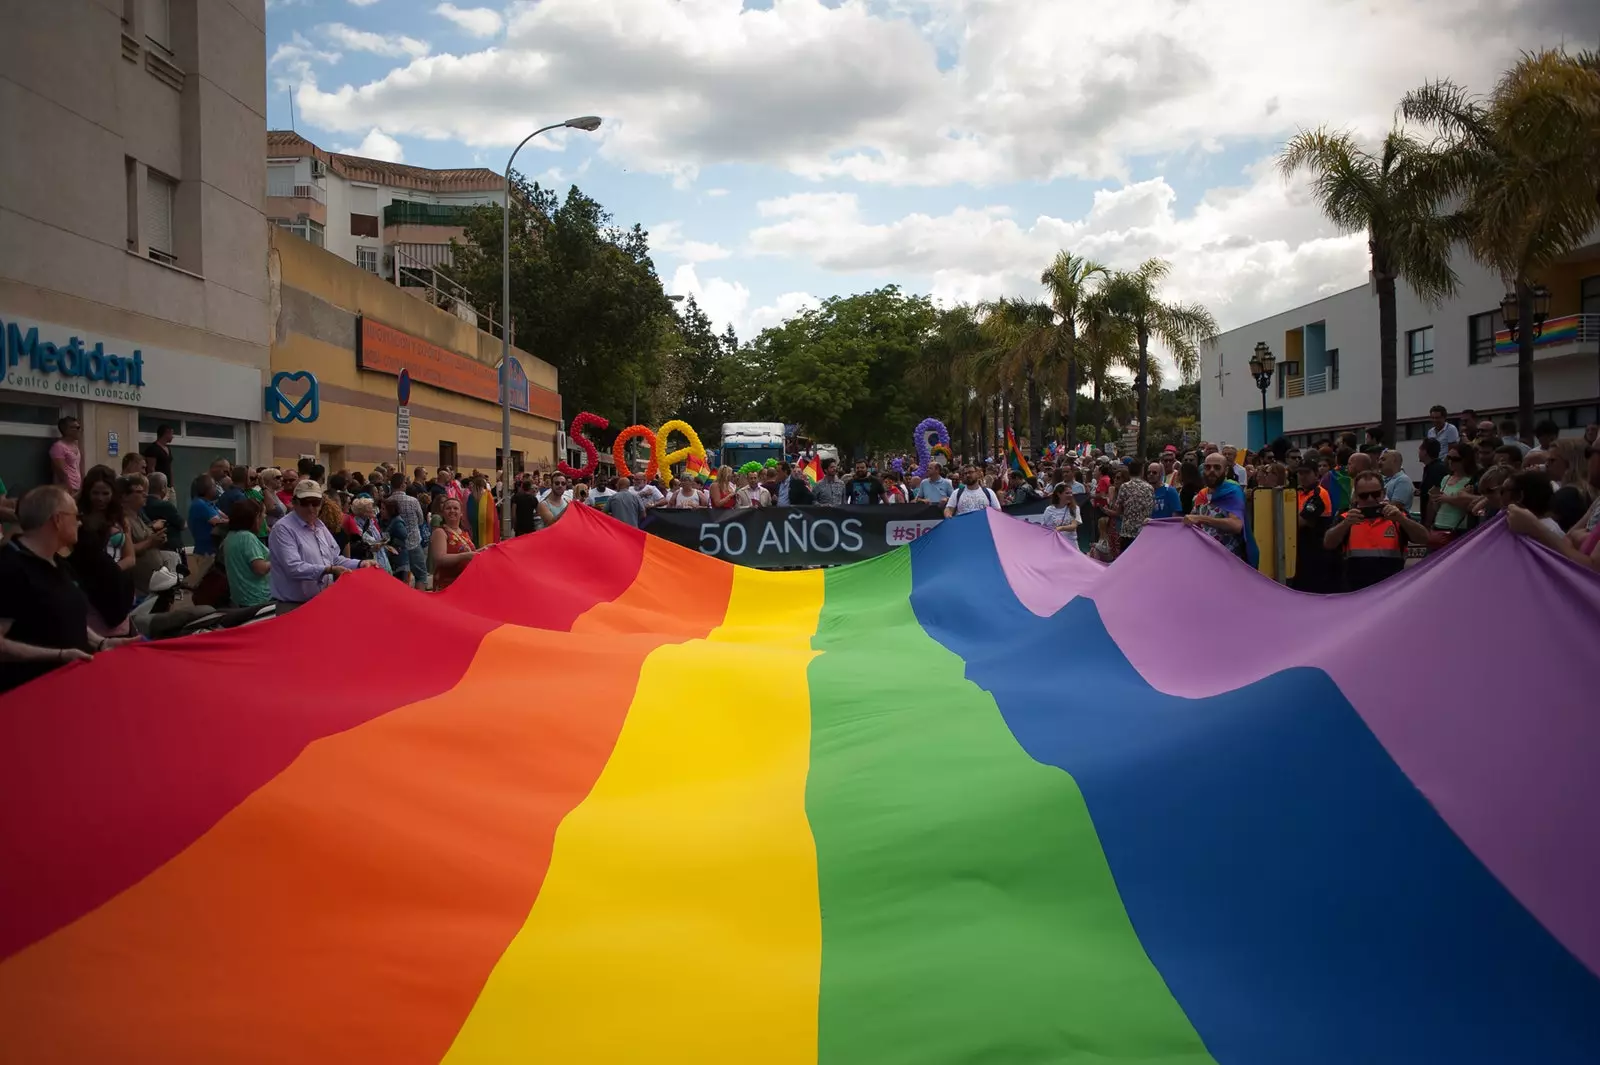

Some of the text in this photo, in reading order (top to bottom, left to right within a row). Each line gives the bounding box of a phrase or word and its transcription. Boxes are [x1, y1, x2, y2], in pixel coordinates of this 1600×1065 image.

[7, 322, 145, 386] Medident
[7, 372, 142, 402] Centro dental avanzado
[698, 513, 864, 556] 50 AÑOS
